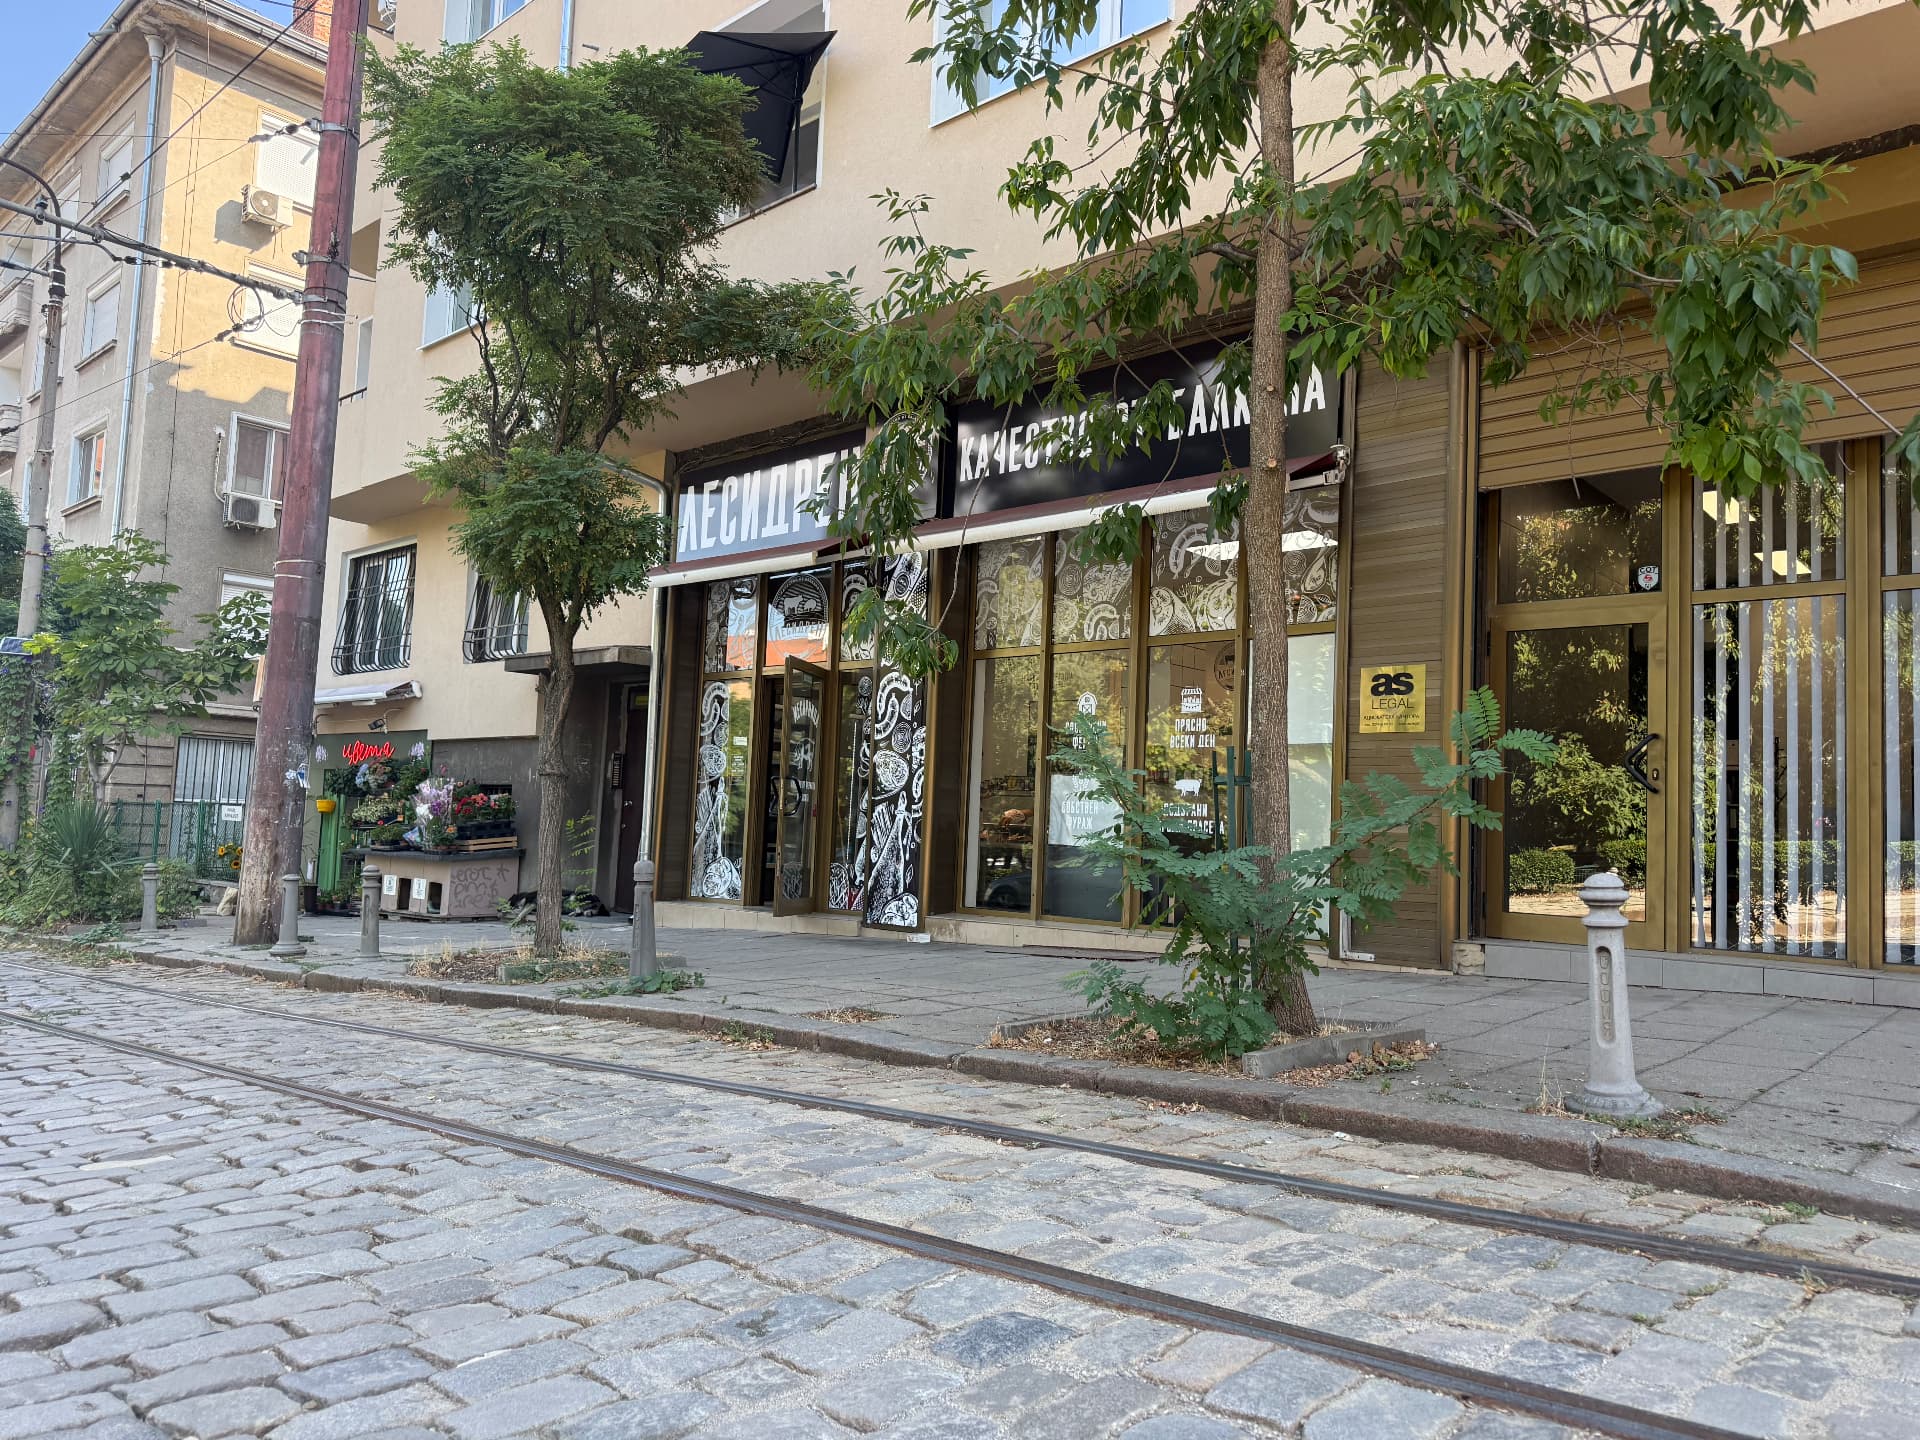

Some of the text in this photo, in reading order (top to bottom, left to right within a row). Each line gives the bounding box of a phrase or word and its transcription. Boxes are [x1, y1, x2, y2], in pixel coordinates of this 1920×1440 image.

[1168, 360, 1326, 441] БАЛКА
[1370, 672, 1414, 696] as
[1371, 697, 1415, 710] LEGAL
[1175, 718, 1207, 732] ПРЯСНО
[1170, 734, 1216, 749] ВСЕКИ ДЕН
[1061, 800, 1099, 814] СОБСТВЕН
